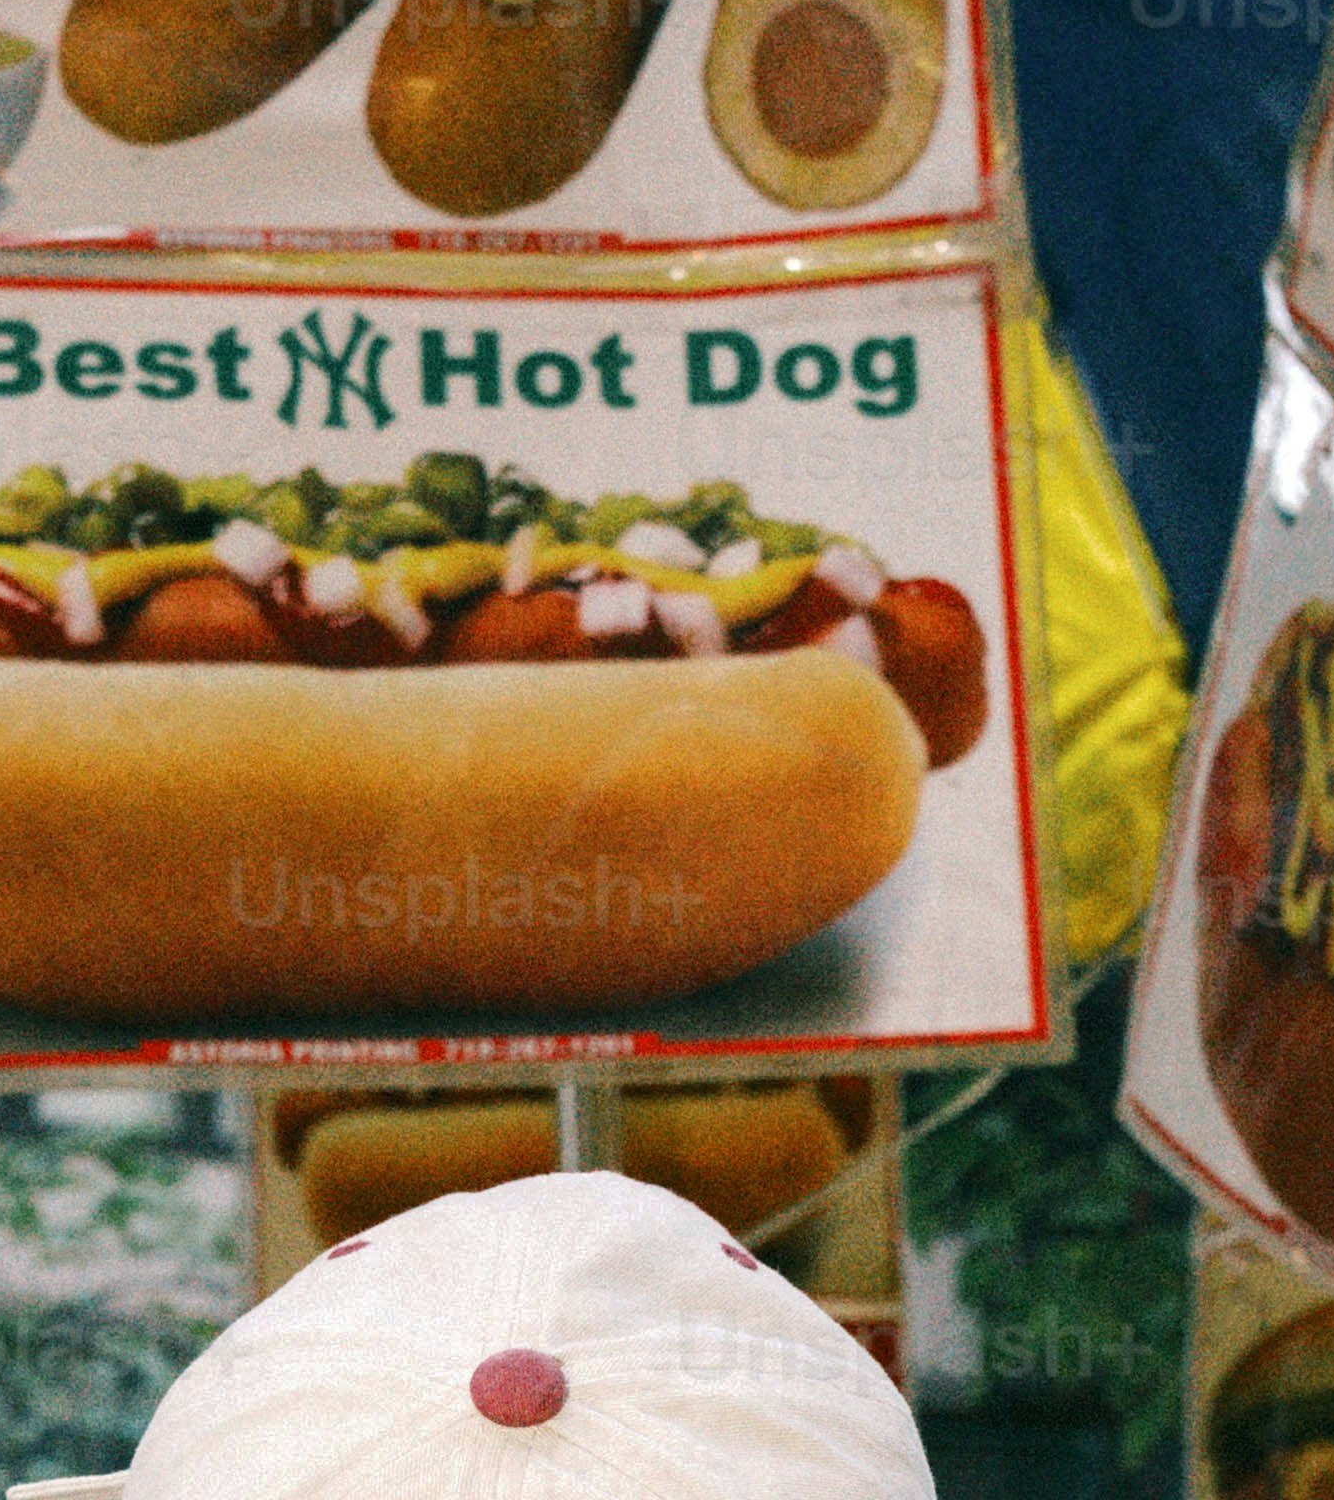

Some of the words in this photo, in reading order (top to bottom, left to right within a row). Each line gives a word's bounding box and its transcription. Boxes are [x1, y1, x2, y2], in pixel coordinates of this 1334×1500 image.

[276, 310, 397, 430] NY
[419, 327, 637, 410] Hot
[684, 329, 920, 419] Dog
